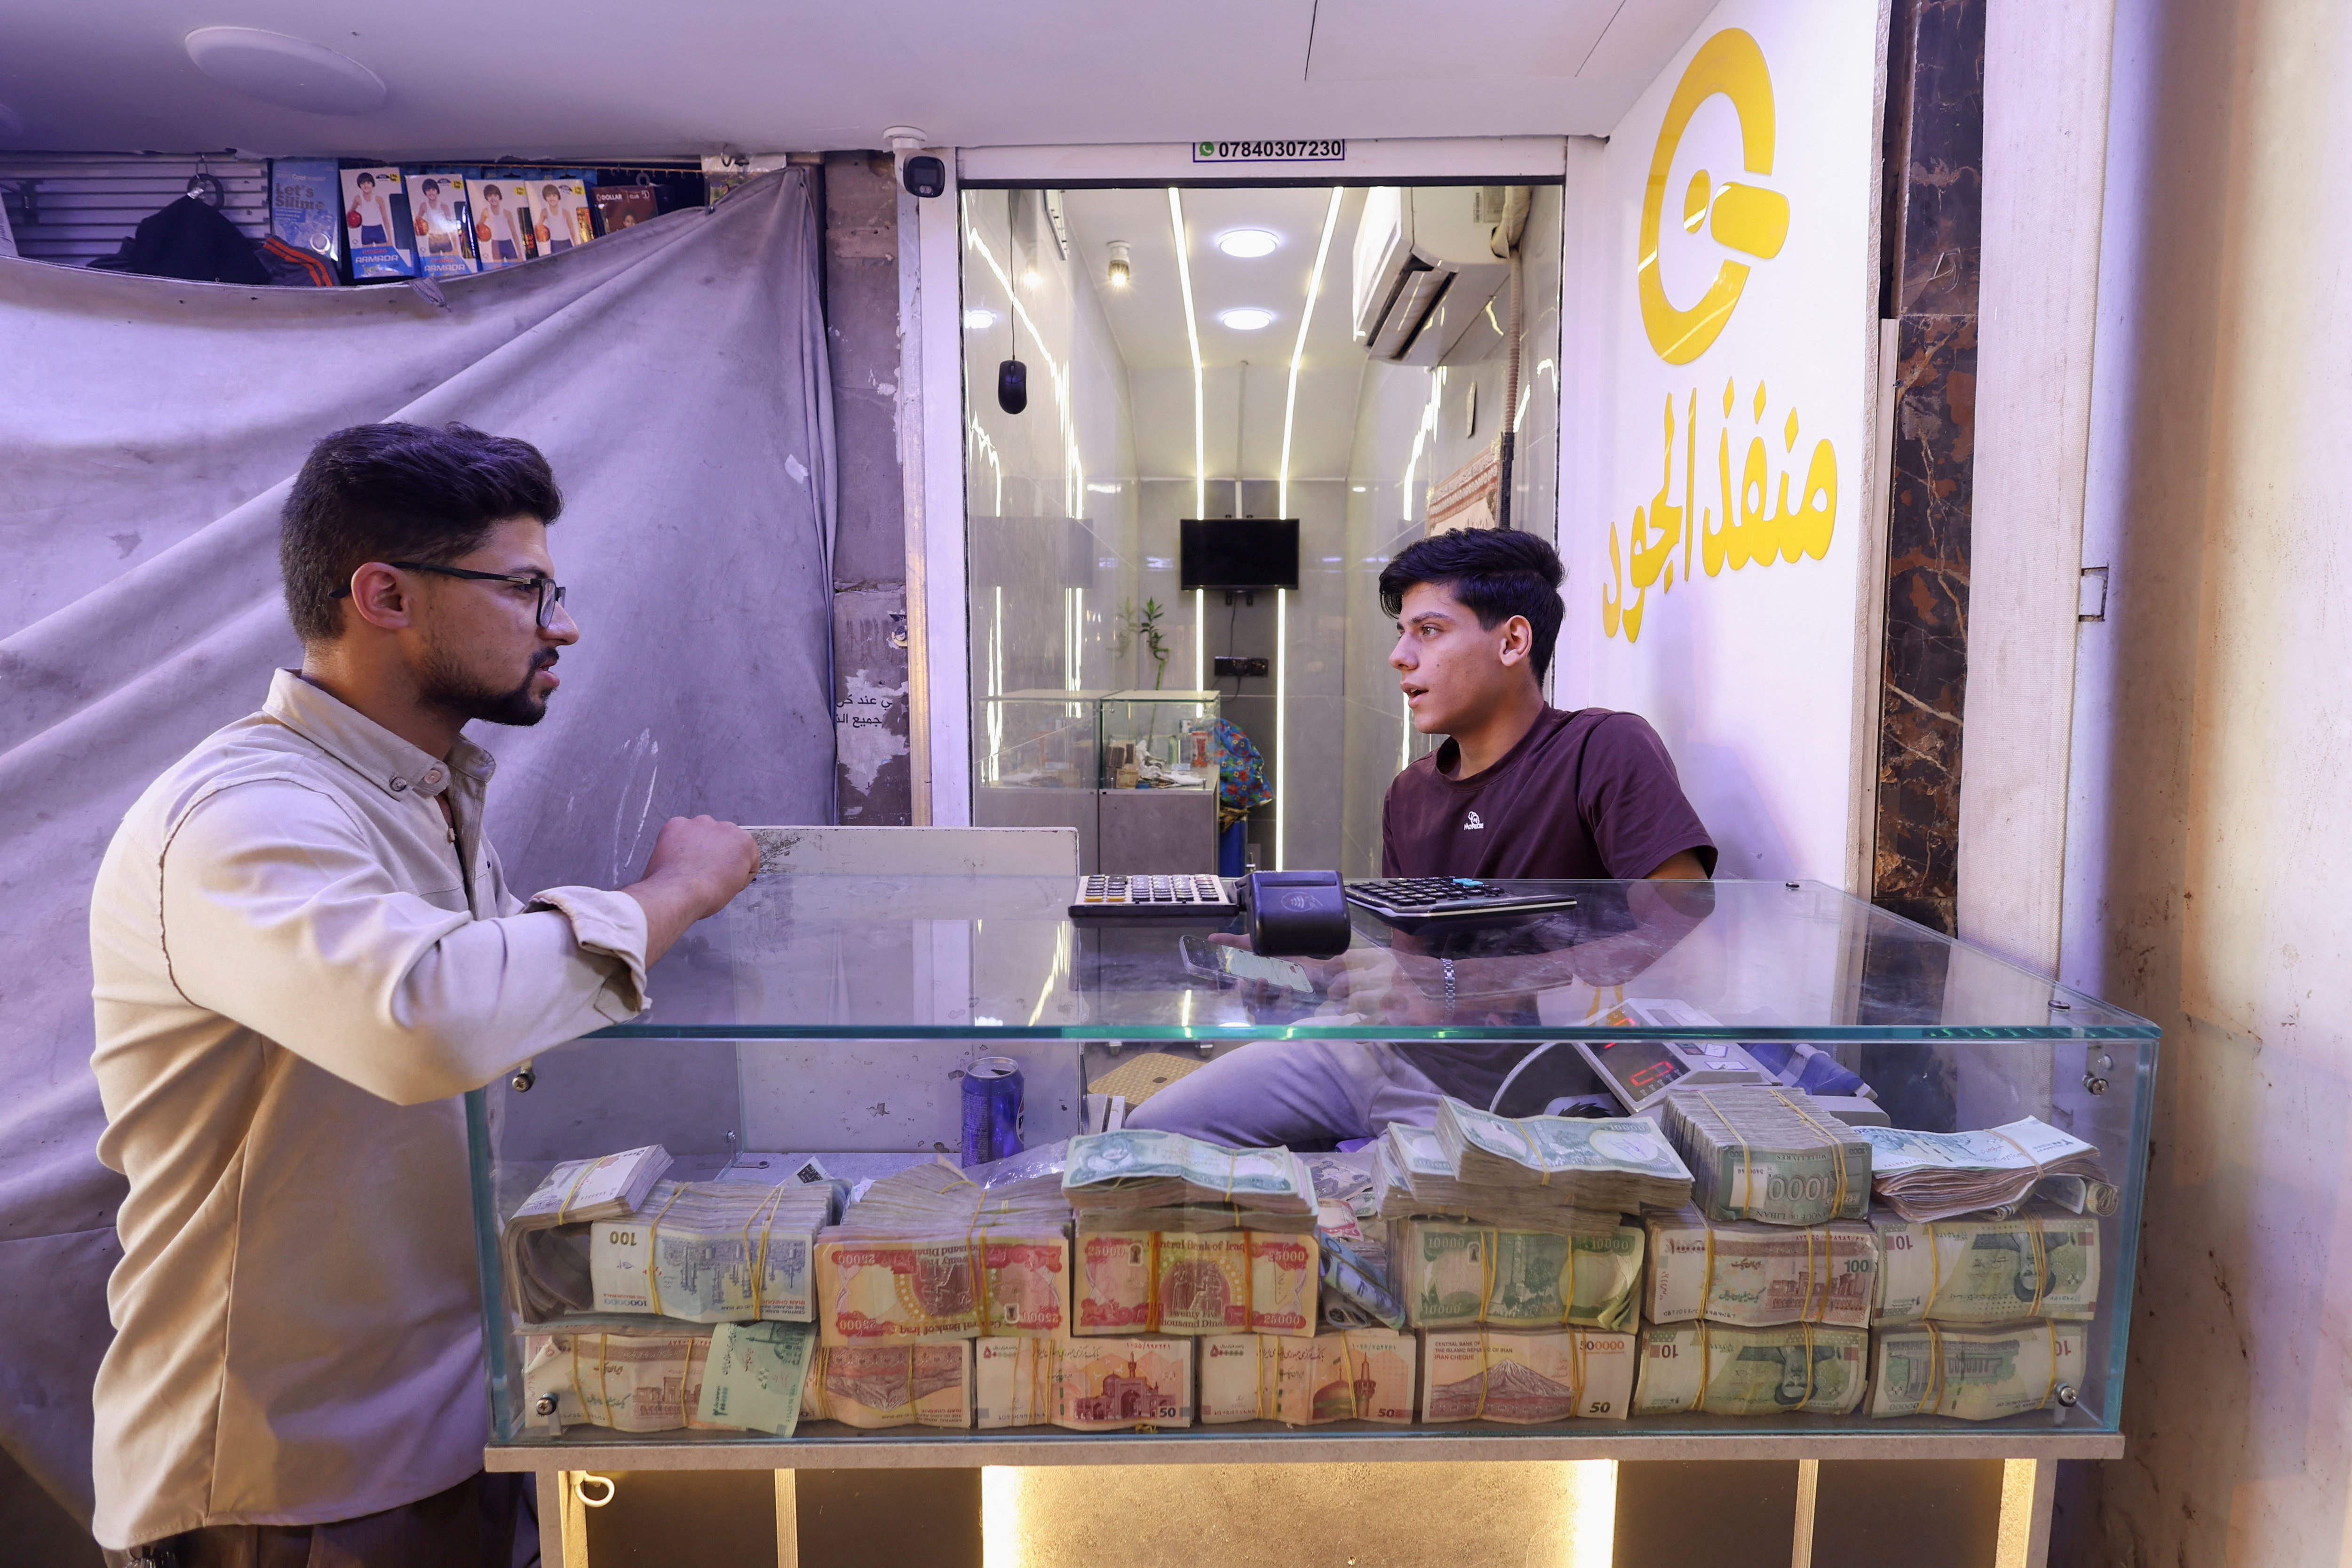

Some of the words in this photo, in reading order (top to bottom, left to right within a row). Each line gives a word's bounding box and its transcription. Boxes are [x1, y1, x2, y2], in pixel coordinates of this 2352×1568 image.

[1219, 141, 1341, 157] 07840307230
[276, 183, 314, 198] Let's
[355, 255, 398, 263] ARMADA
[1702, 376, 1837, 577] منفذ
[1603, 387, 1696, 643] الجود
[858, 696, 876, 704] عند
[1768, 1177, 1832, 1201] 1000
[1757, 1210, 1786, 1220] LIBAN
[610, 1231, 637, 1246] 100
[1428, 1237, 1465, 1248] 10000
[1896, 1236, 1913, 1250] 10
[1187, 1241, 1209, 1250] Bank
[1212, 1241, 1222, 1250] of
[1225, 1242, 1245, 1253] Iraq
[1592, 1239, 1629, 1250] 10000
[1088, 1246, 1125, 1257] 25000
[1268, 1251, 1305, 1261] 25000
[838, 1254, 875, 1265] 25000
[1844, 1259, 1869, 1273] 100
[604, 1298, 648, 1307] 1000000
[1423, 1305, 1461, 1314] 10000
[839, 1319, 876, 1330] 25000
[1263, 1315, 1300, 1325] 25000
[899, 1325, 921, 1335] Iraq
[922, 1324, 934, 1335] of
[935, 1322, 961, 1333] Bank
[1310, 1346, 1326, 1361] بانک
[1661, 1345, 1679, 1359] 10
[1159, 1408, 1176, 1417] 50
[1589, 1401, 1611, 1413] 50
[1377, 1409, 1395, 1417] 50
